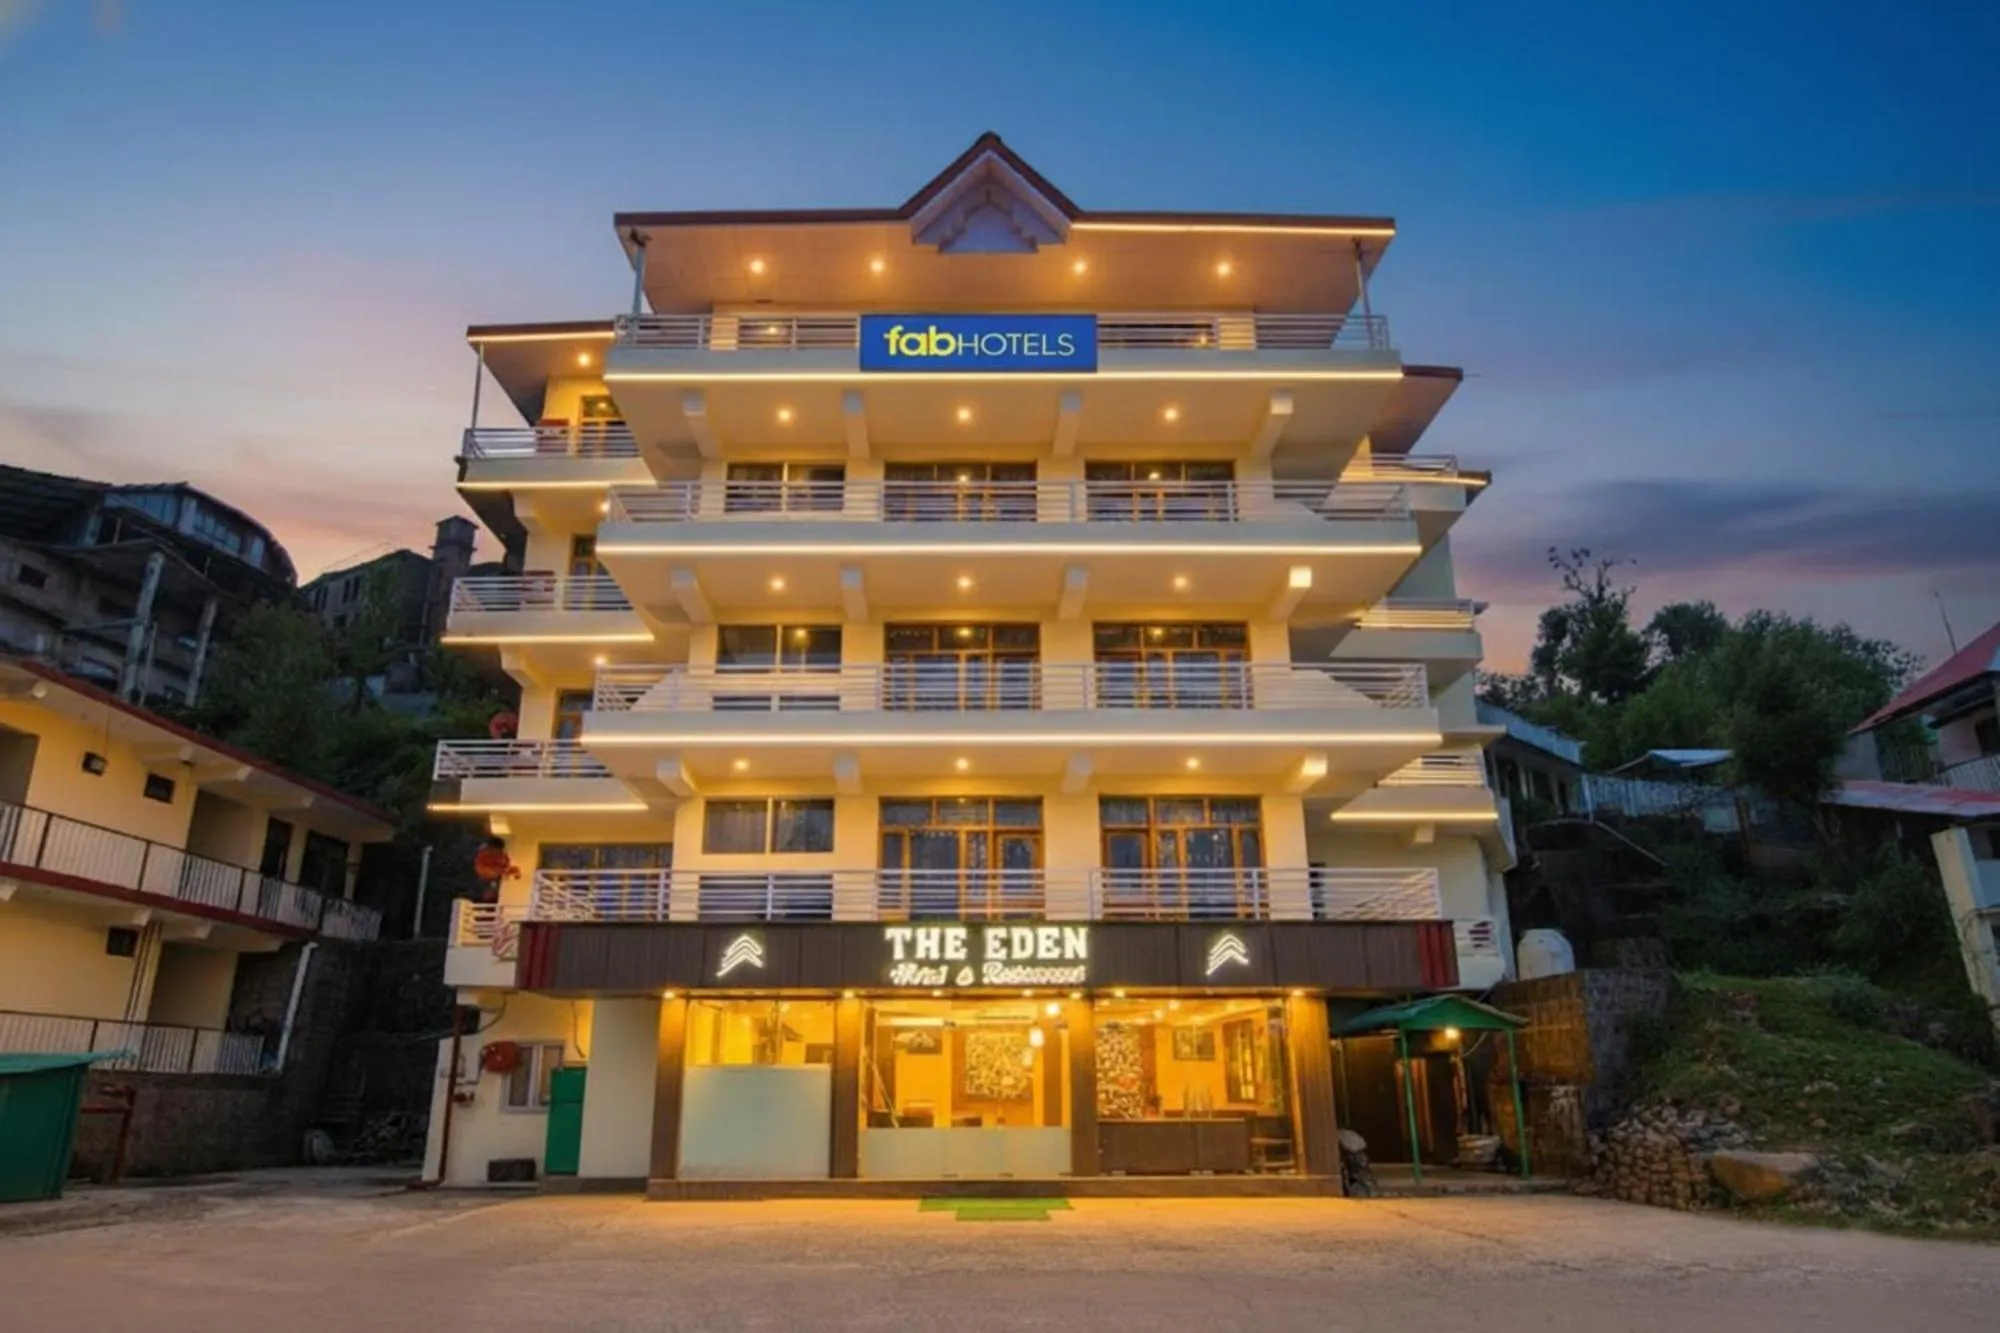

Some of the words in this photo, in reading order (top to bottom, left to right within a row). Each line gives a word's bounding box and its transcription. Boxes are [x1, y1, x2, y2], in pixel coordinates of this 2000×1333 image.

[883, 325, 1075, 356] fabHOTELS
[884, 926, 968, 960] THE
[983, 926, 1089, 960] EDEN
